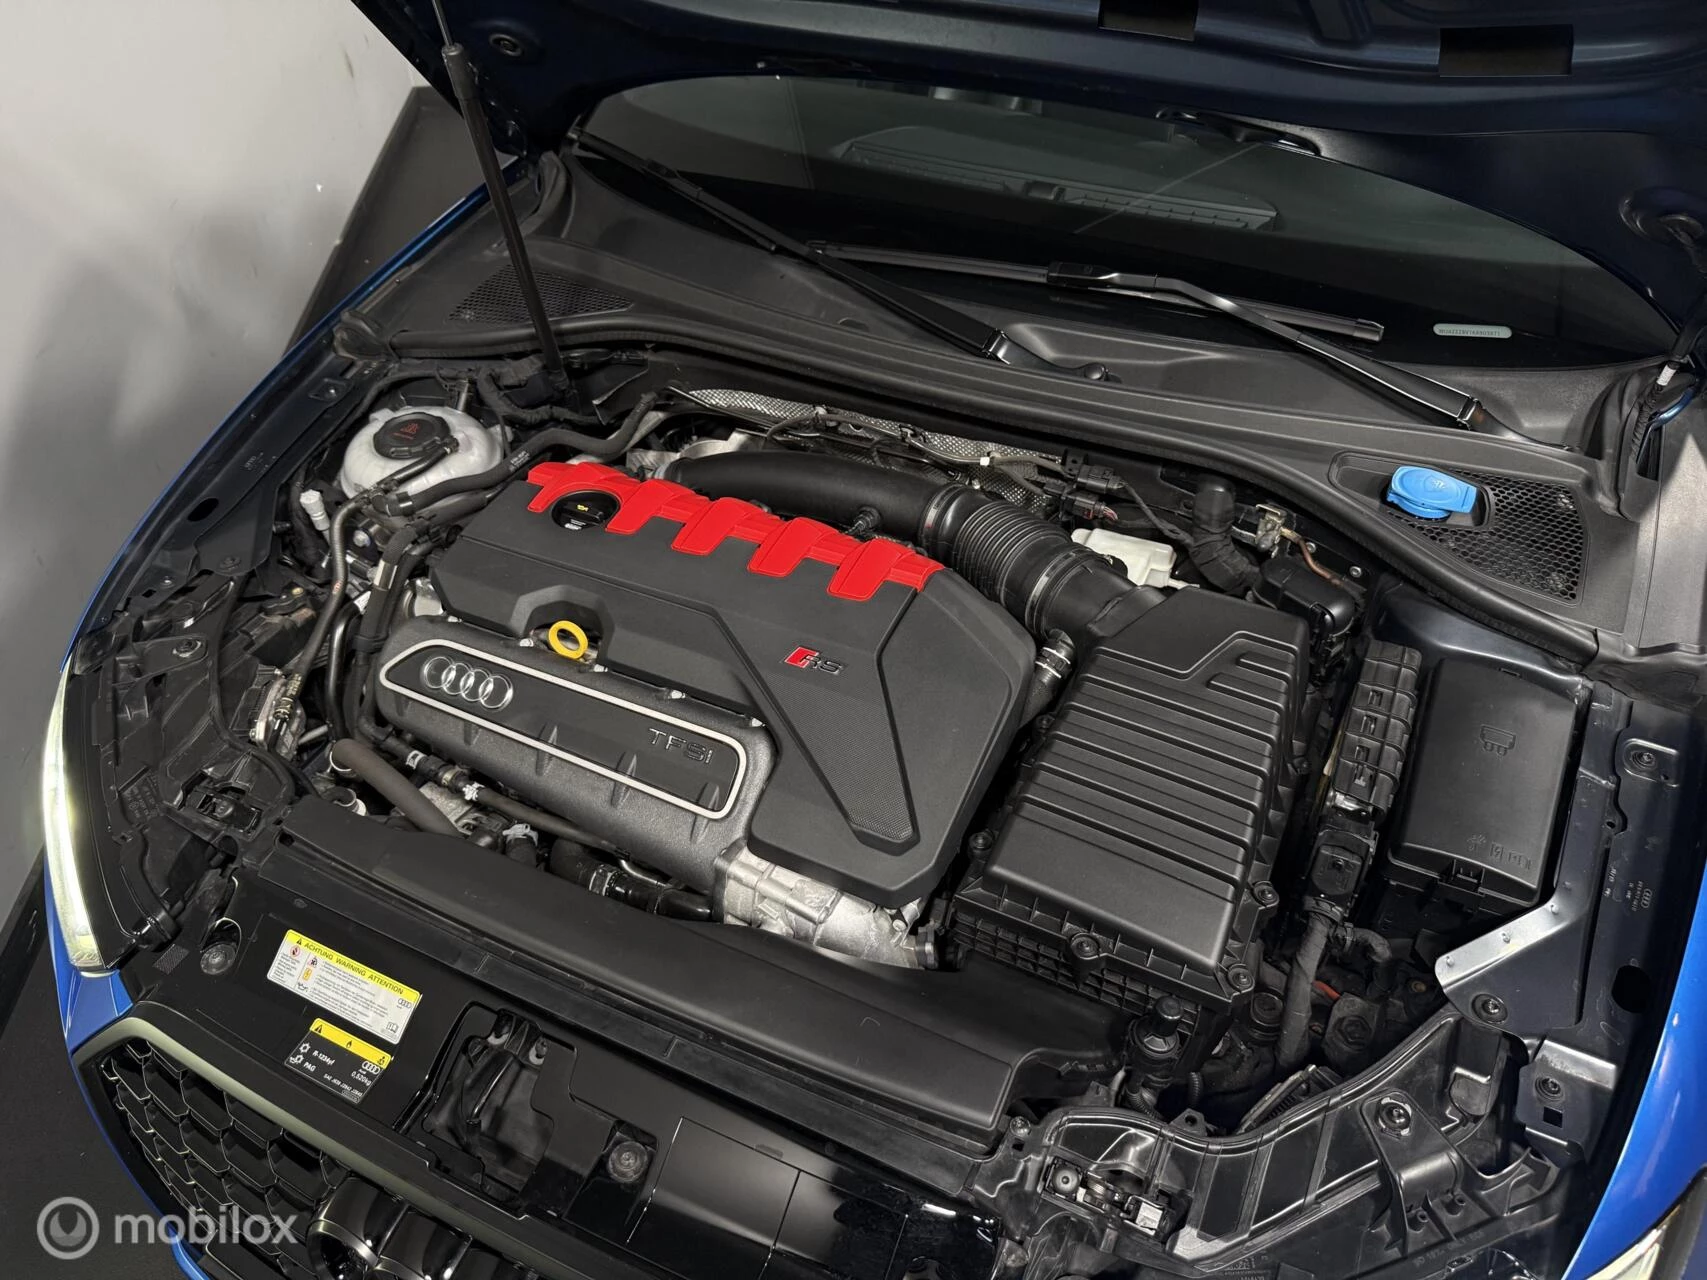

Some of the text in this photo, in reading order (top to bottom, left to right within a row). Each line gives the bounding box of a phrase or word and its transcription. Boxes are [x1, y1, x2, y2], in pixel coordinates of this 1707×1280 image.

[796, 651, 842, 675] RS
[649, 728, 714, 764] TFSI
[304, 942, 404, 995] ACHTUNG WARNING ATTENTION
[303, 1061, 316, 1072] PAG
